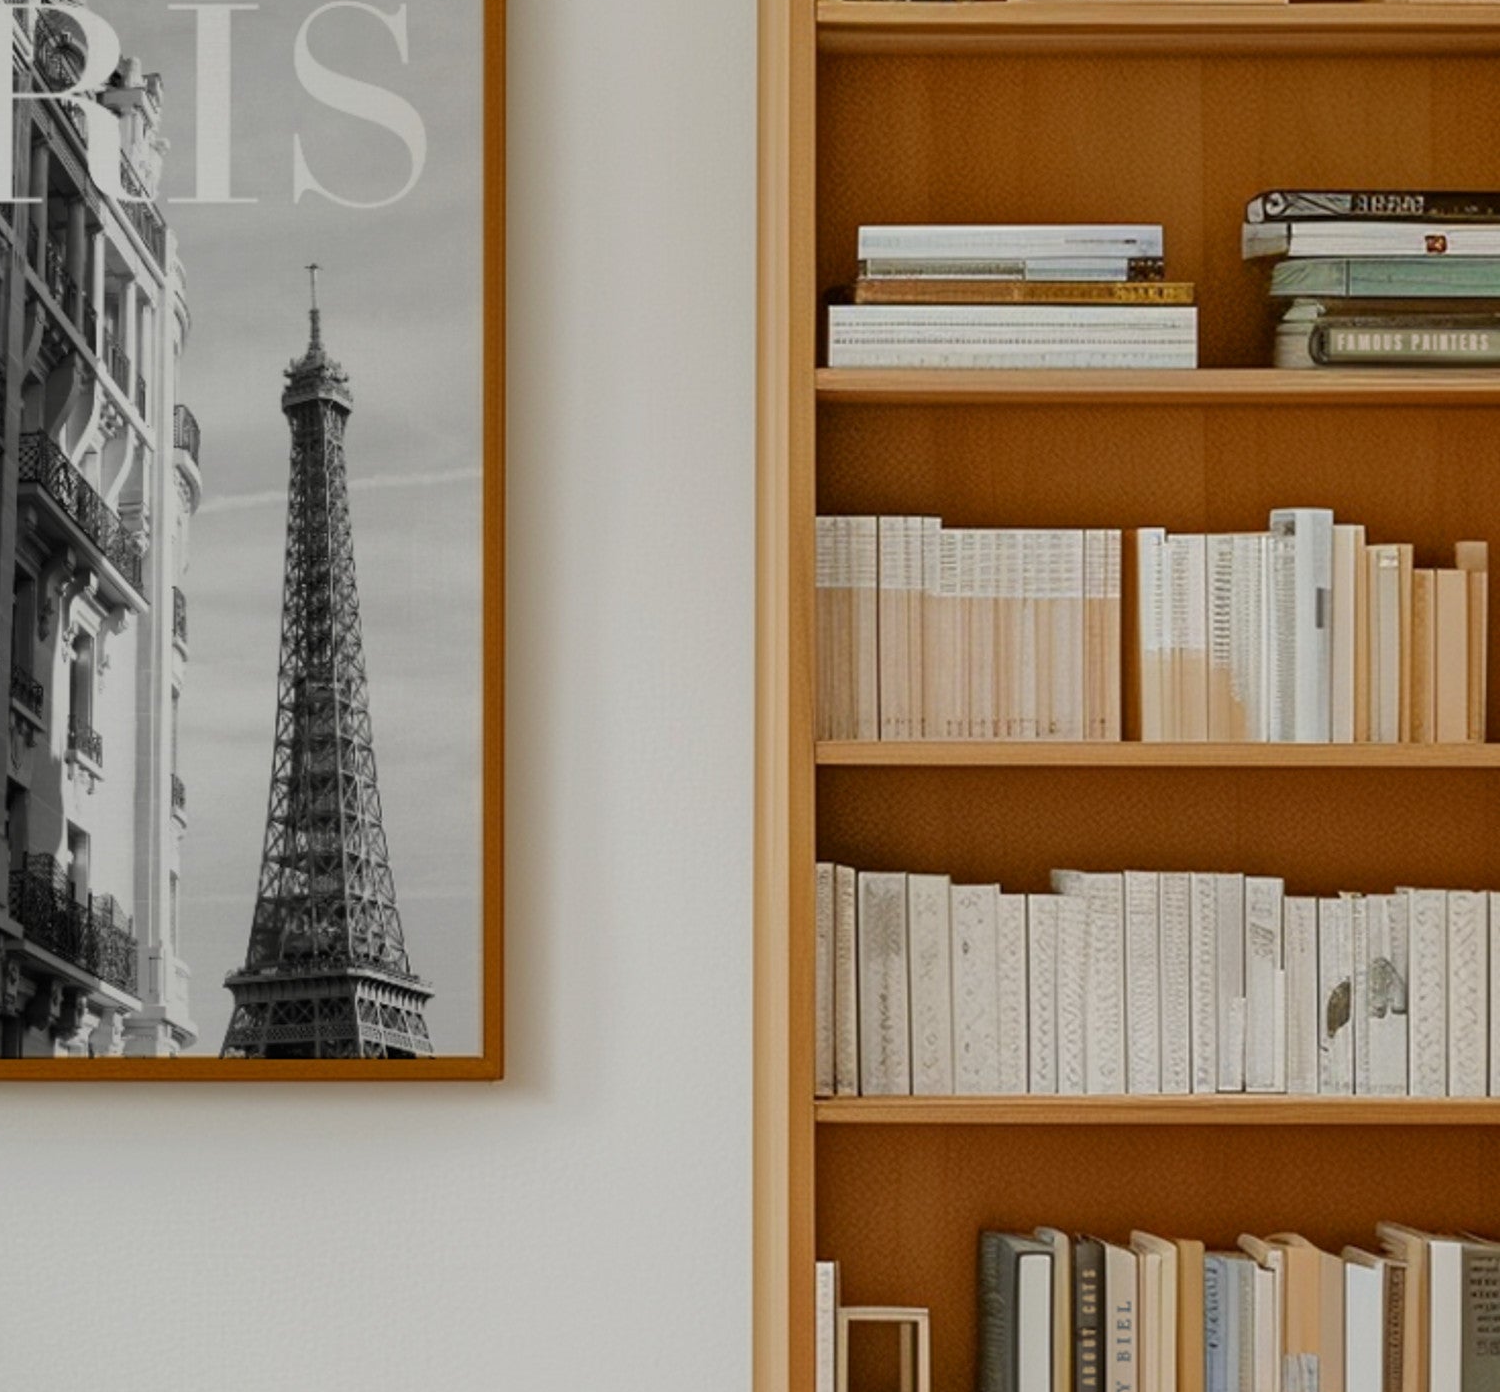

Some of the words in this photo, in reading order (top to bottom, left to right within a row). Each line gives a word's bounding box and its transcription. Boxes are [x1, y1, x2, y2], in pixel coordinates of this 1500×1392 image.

[1336, 333, 1402, 351] FAMOUS
[1410, 333, 1490, 351] PAINTERS
[1081, 1268, 1097, 1314] CATS
[1081, 1327, 1097, 1386] ABOUT
[1116, 1300, 1132, 1362] BIEL
